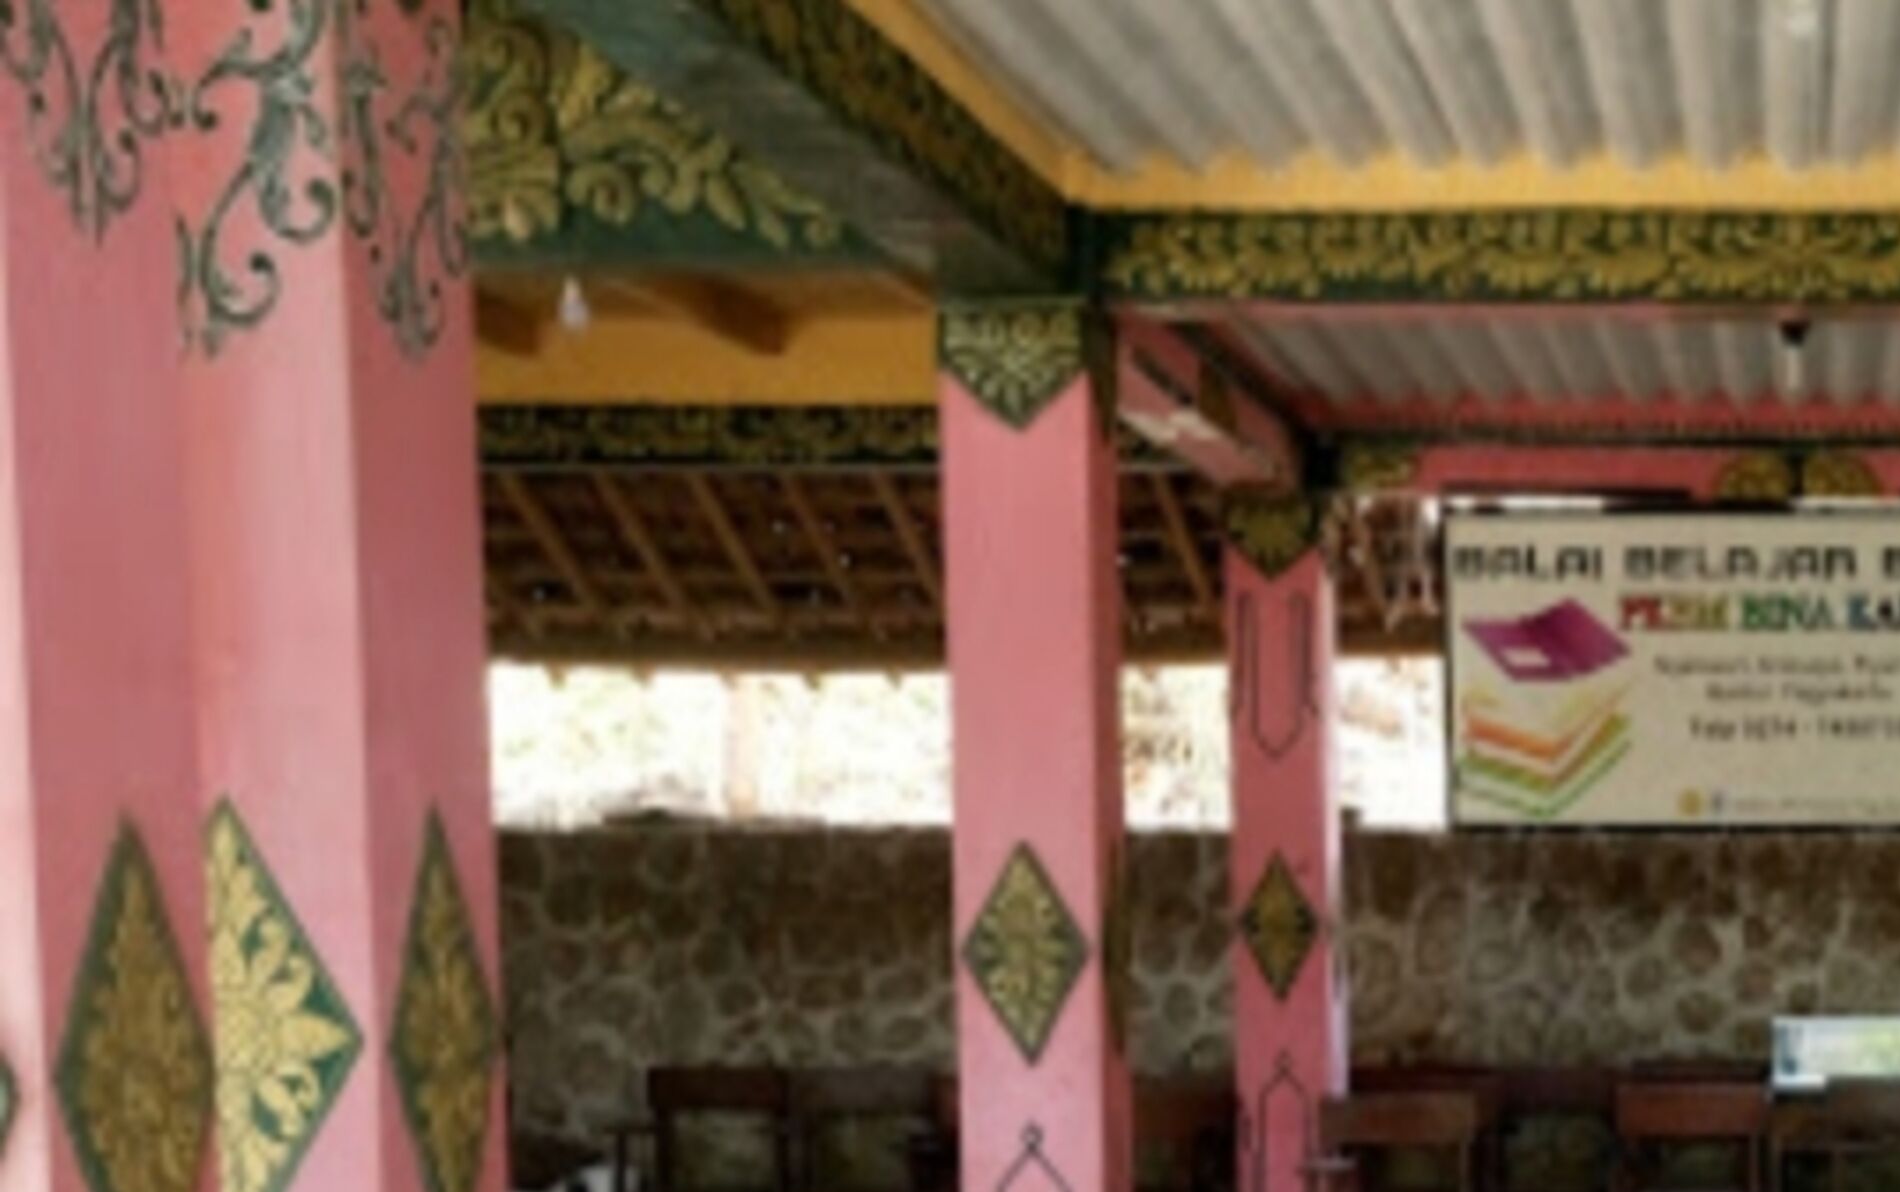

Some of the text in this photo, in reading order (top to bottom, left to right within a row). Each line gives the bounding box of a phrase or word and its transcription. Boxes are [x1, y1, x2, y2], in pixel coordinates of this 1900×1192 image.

[1453, 545, 1603, 581] BALAI
[1624, 545, 1857, 581] BELAJAR
[1740, 594, 1835, 631] BINA
